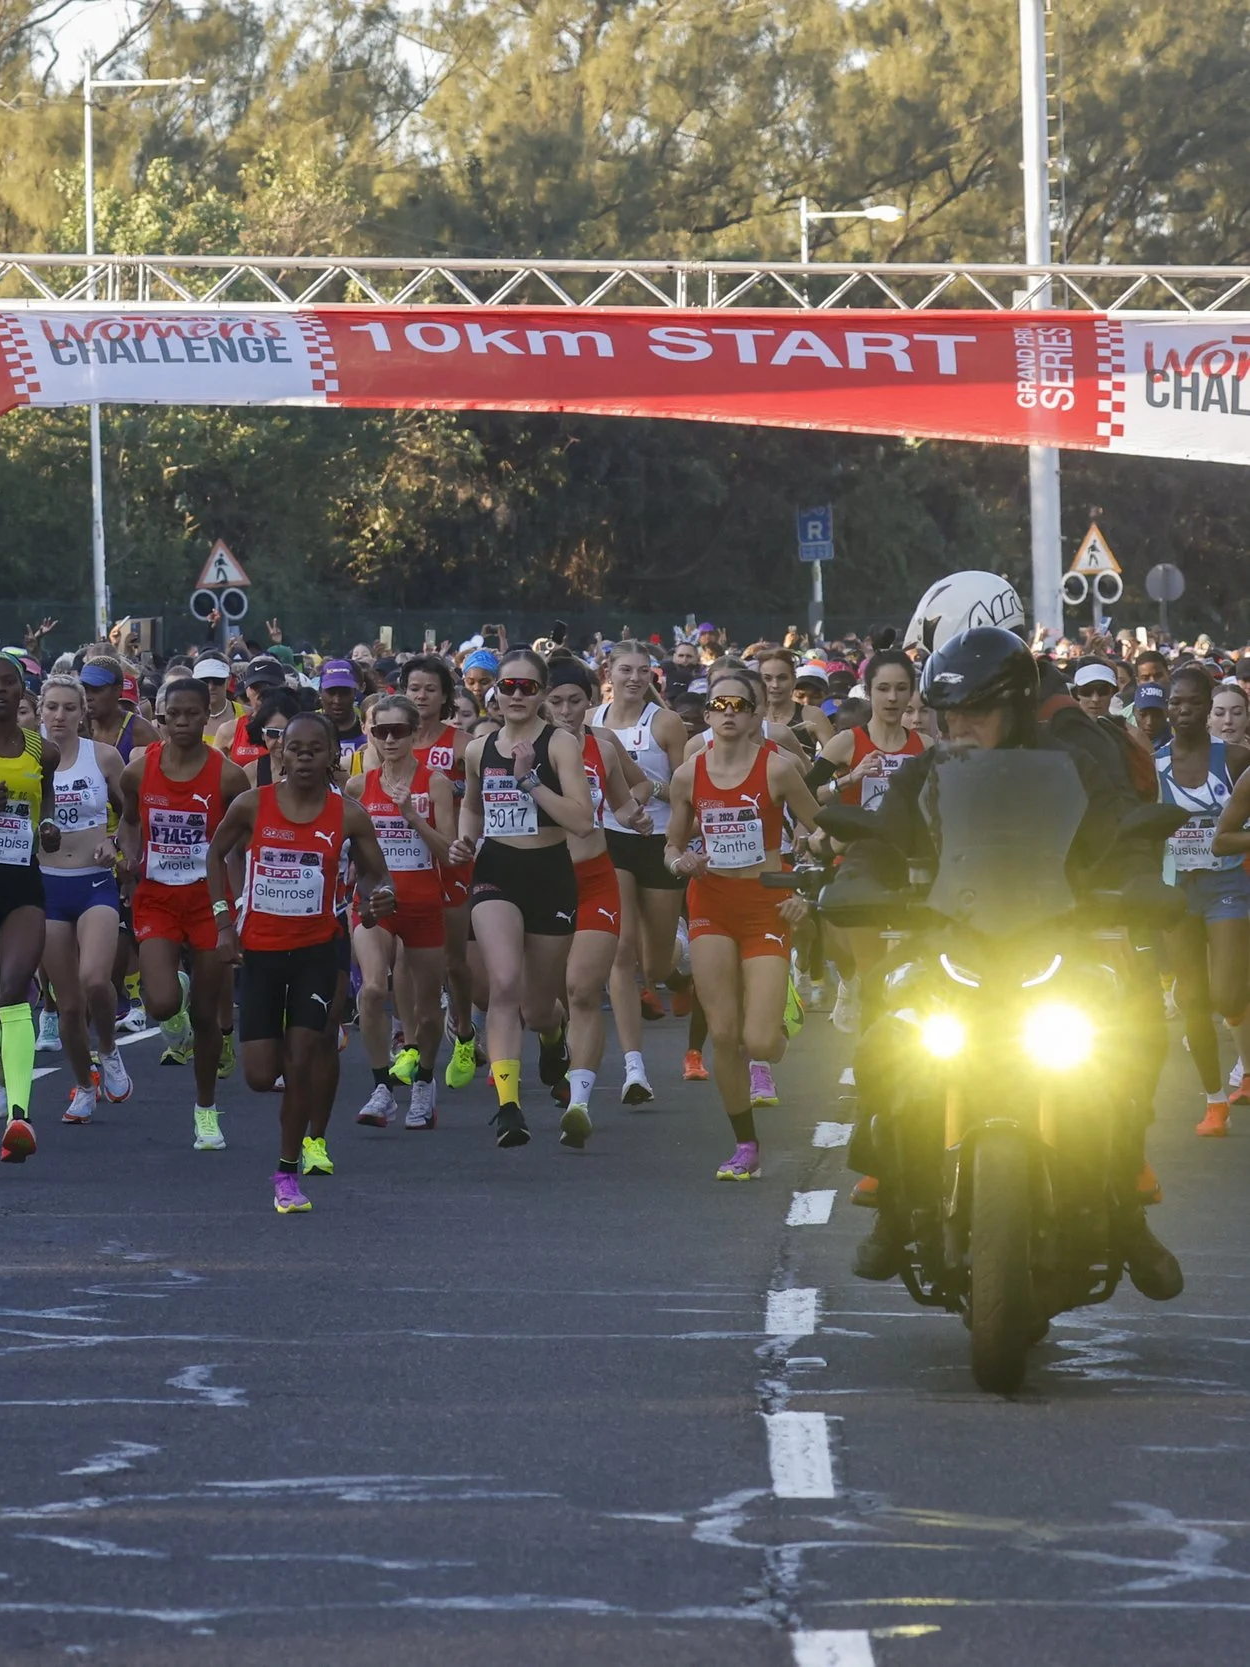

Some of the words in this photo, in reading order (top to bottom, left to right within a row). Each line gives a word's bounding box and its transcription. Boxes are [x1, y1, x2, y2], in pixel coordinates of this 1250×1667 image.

[50, 337, 292, 366] CHALLENGE
[350, 322, 614, 357] 10km
[648, 326, 977, 375] START
[1037, 327, 1075, 411] SERIES
[1016, 349, 1038, 409] GRAND
[430, 751, 451, 766] 60
[58, 808, 78, 825] 98
[168, 814, 183, 823] 2025
[489, 808, 528, 828] 5017
[719, 813, 734, 821] 2025
[712, 824, 746, 833] SPAR
[380, 830, 412, 838] SPAR
[1174, 830, 1204, 838] SPAR
[158, 845, 190, 854] SPAR
[383, 847, 421, 856] anene
[712, 840, 757, 853] Zanthe
[1168, 845, 1211, 856] Busisiw
[280, 853, 296, 863] 2025
[158, 860, 195, 870] Violet
[264, 868, 300, 878] SPAR
[255, 883, 314, 900] Glenrose
